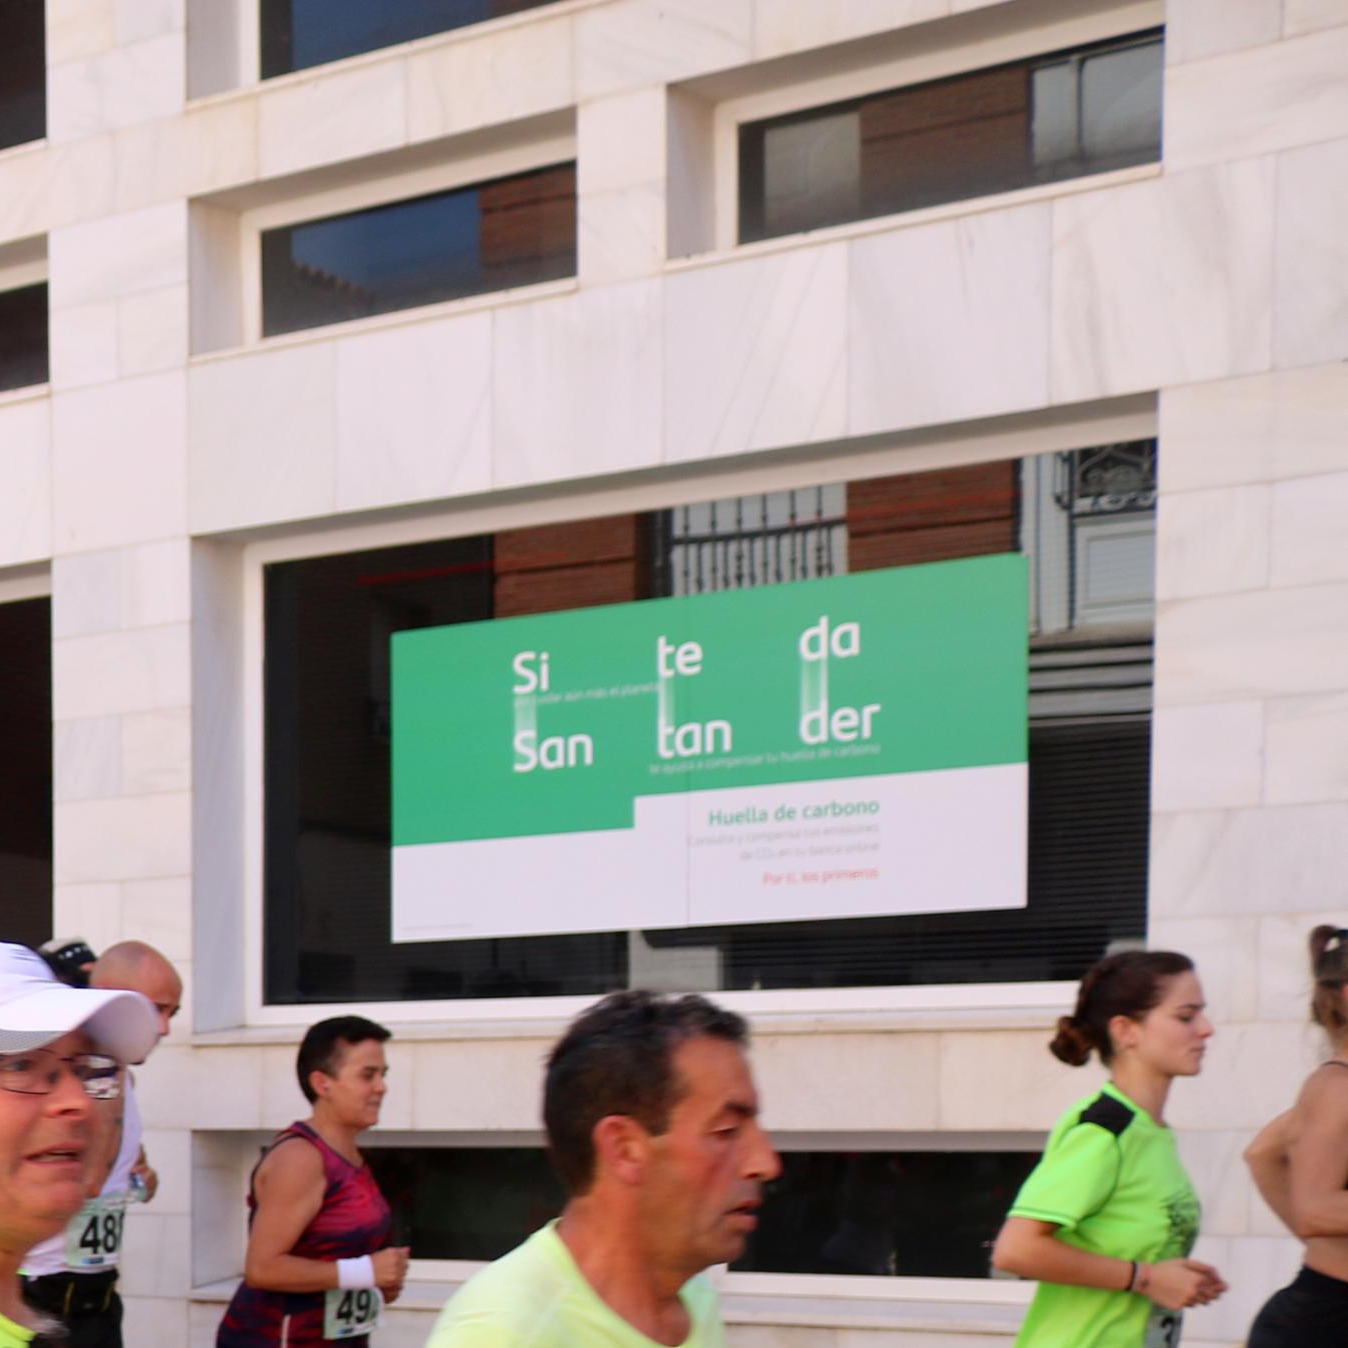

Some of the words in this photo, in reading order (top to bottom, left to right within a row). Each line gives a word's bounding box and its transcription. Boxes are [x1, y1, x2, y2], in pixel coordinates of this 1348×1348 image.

[512, 651, 550, 694] Si
[657, 635, 703, 678] te
[799, 615, 861, 661] da
[512, 730, 594, 773] San
[657, 714, 733, 759] tan
[799, 702, 882, 745] der
[708, 804, 769, 827] Huella
[773, 803, 798, 822] de
[802, 798, 881, 820] carbono
